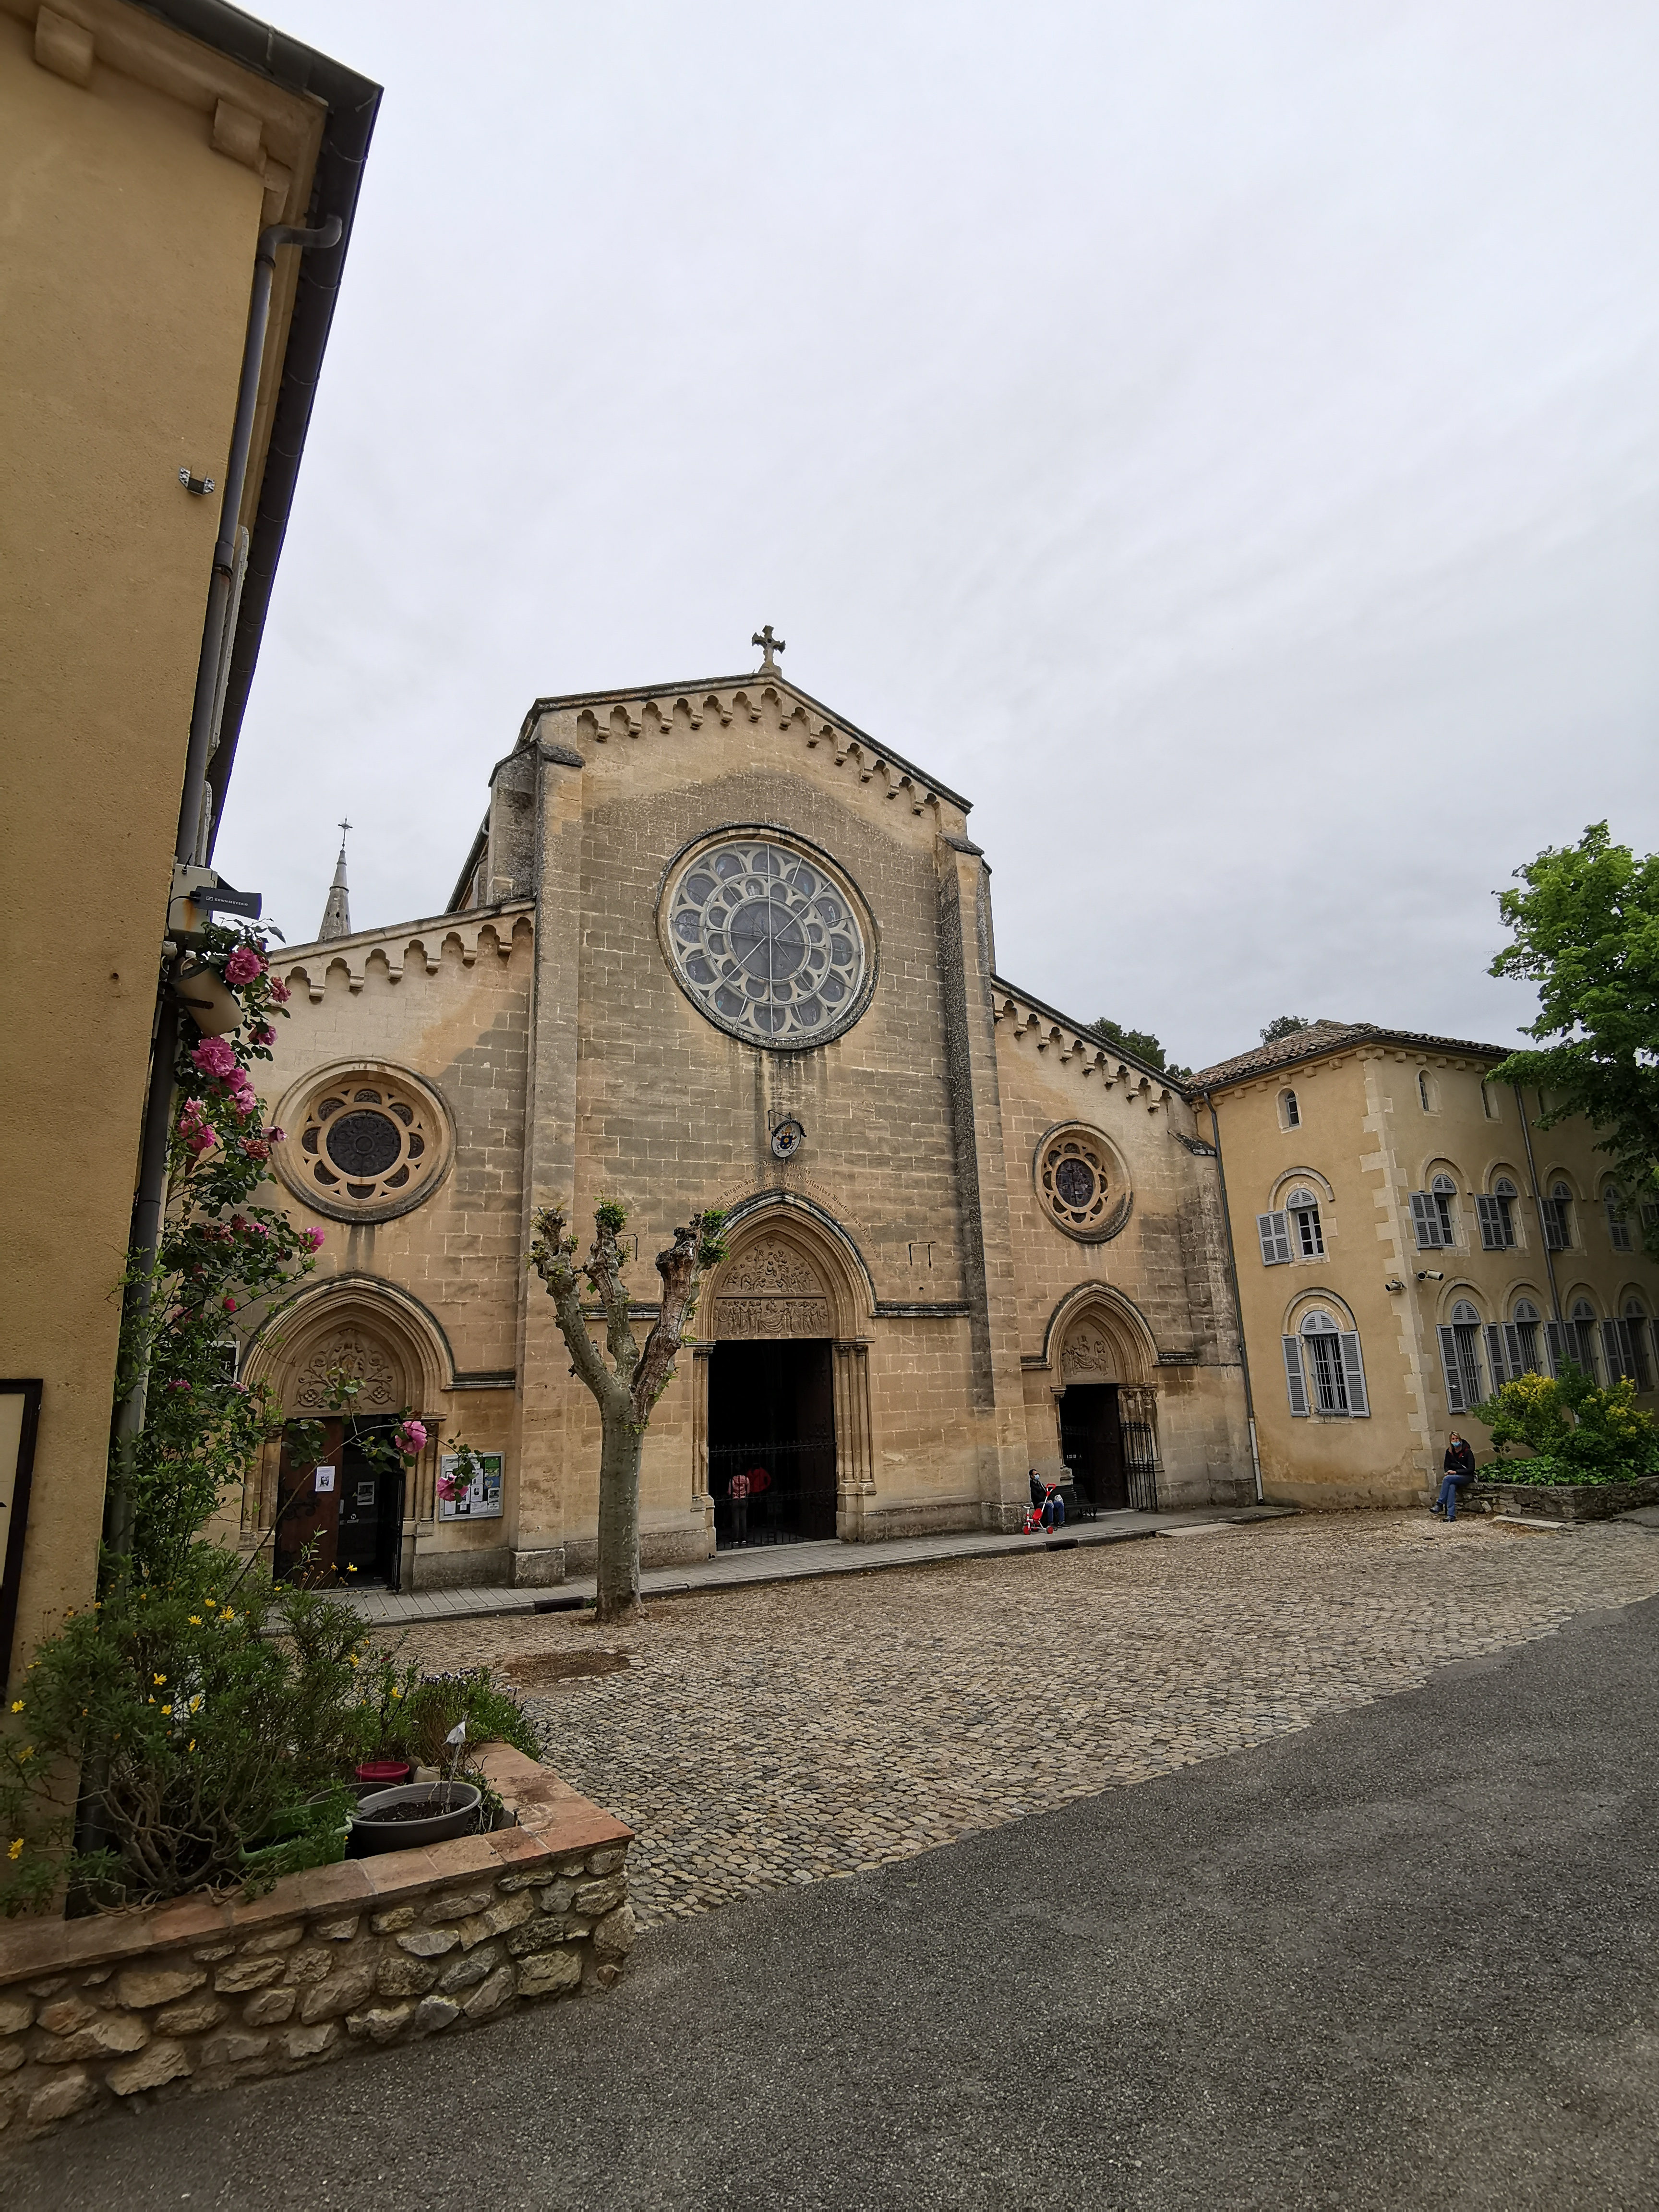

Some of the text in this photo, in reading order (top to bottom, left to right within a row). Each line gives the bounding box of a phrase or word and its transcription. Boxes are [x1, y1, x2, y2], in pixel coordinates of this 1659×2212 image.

[214, 898, 249, 907] SENNHEISER
[722, 1181, 744, 1197] Virgini
[724, 1190, 751, 1208] Quorum
